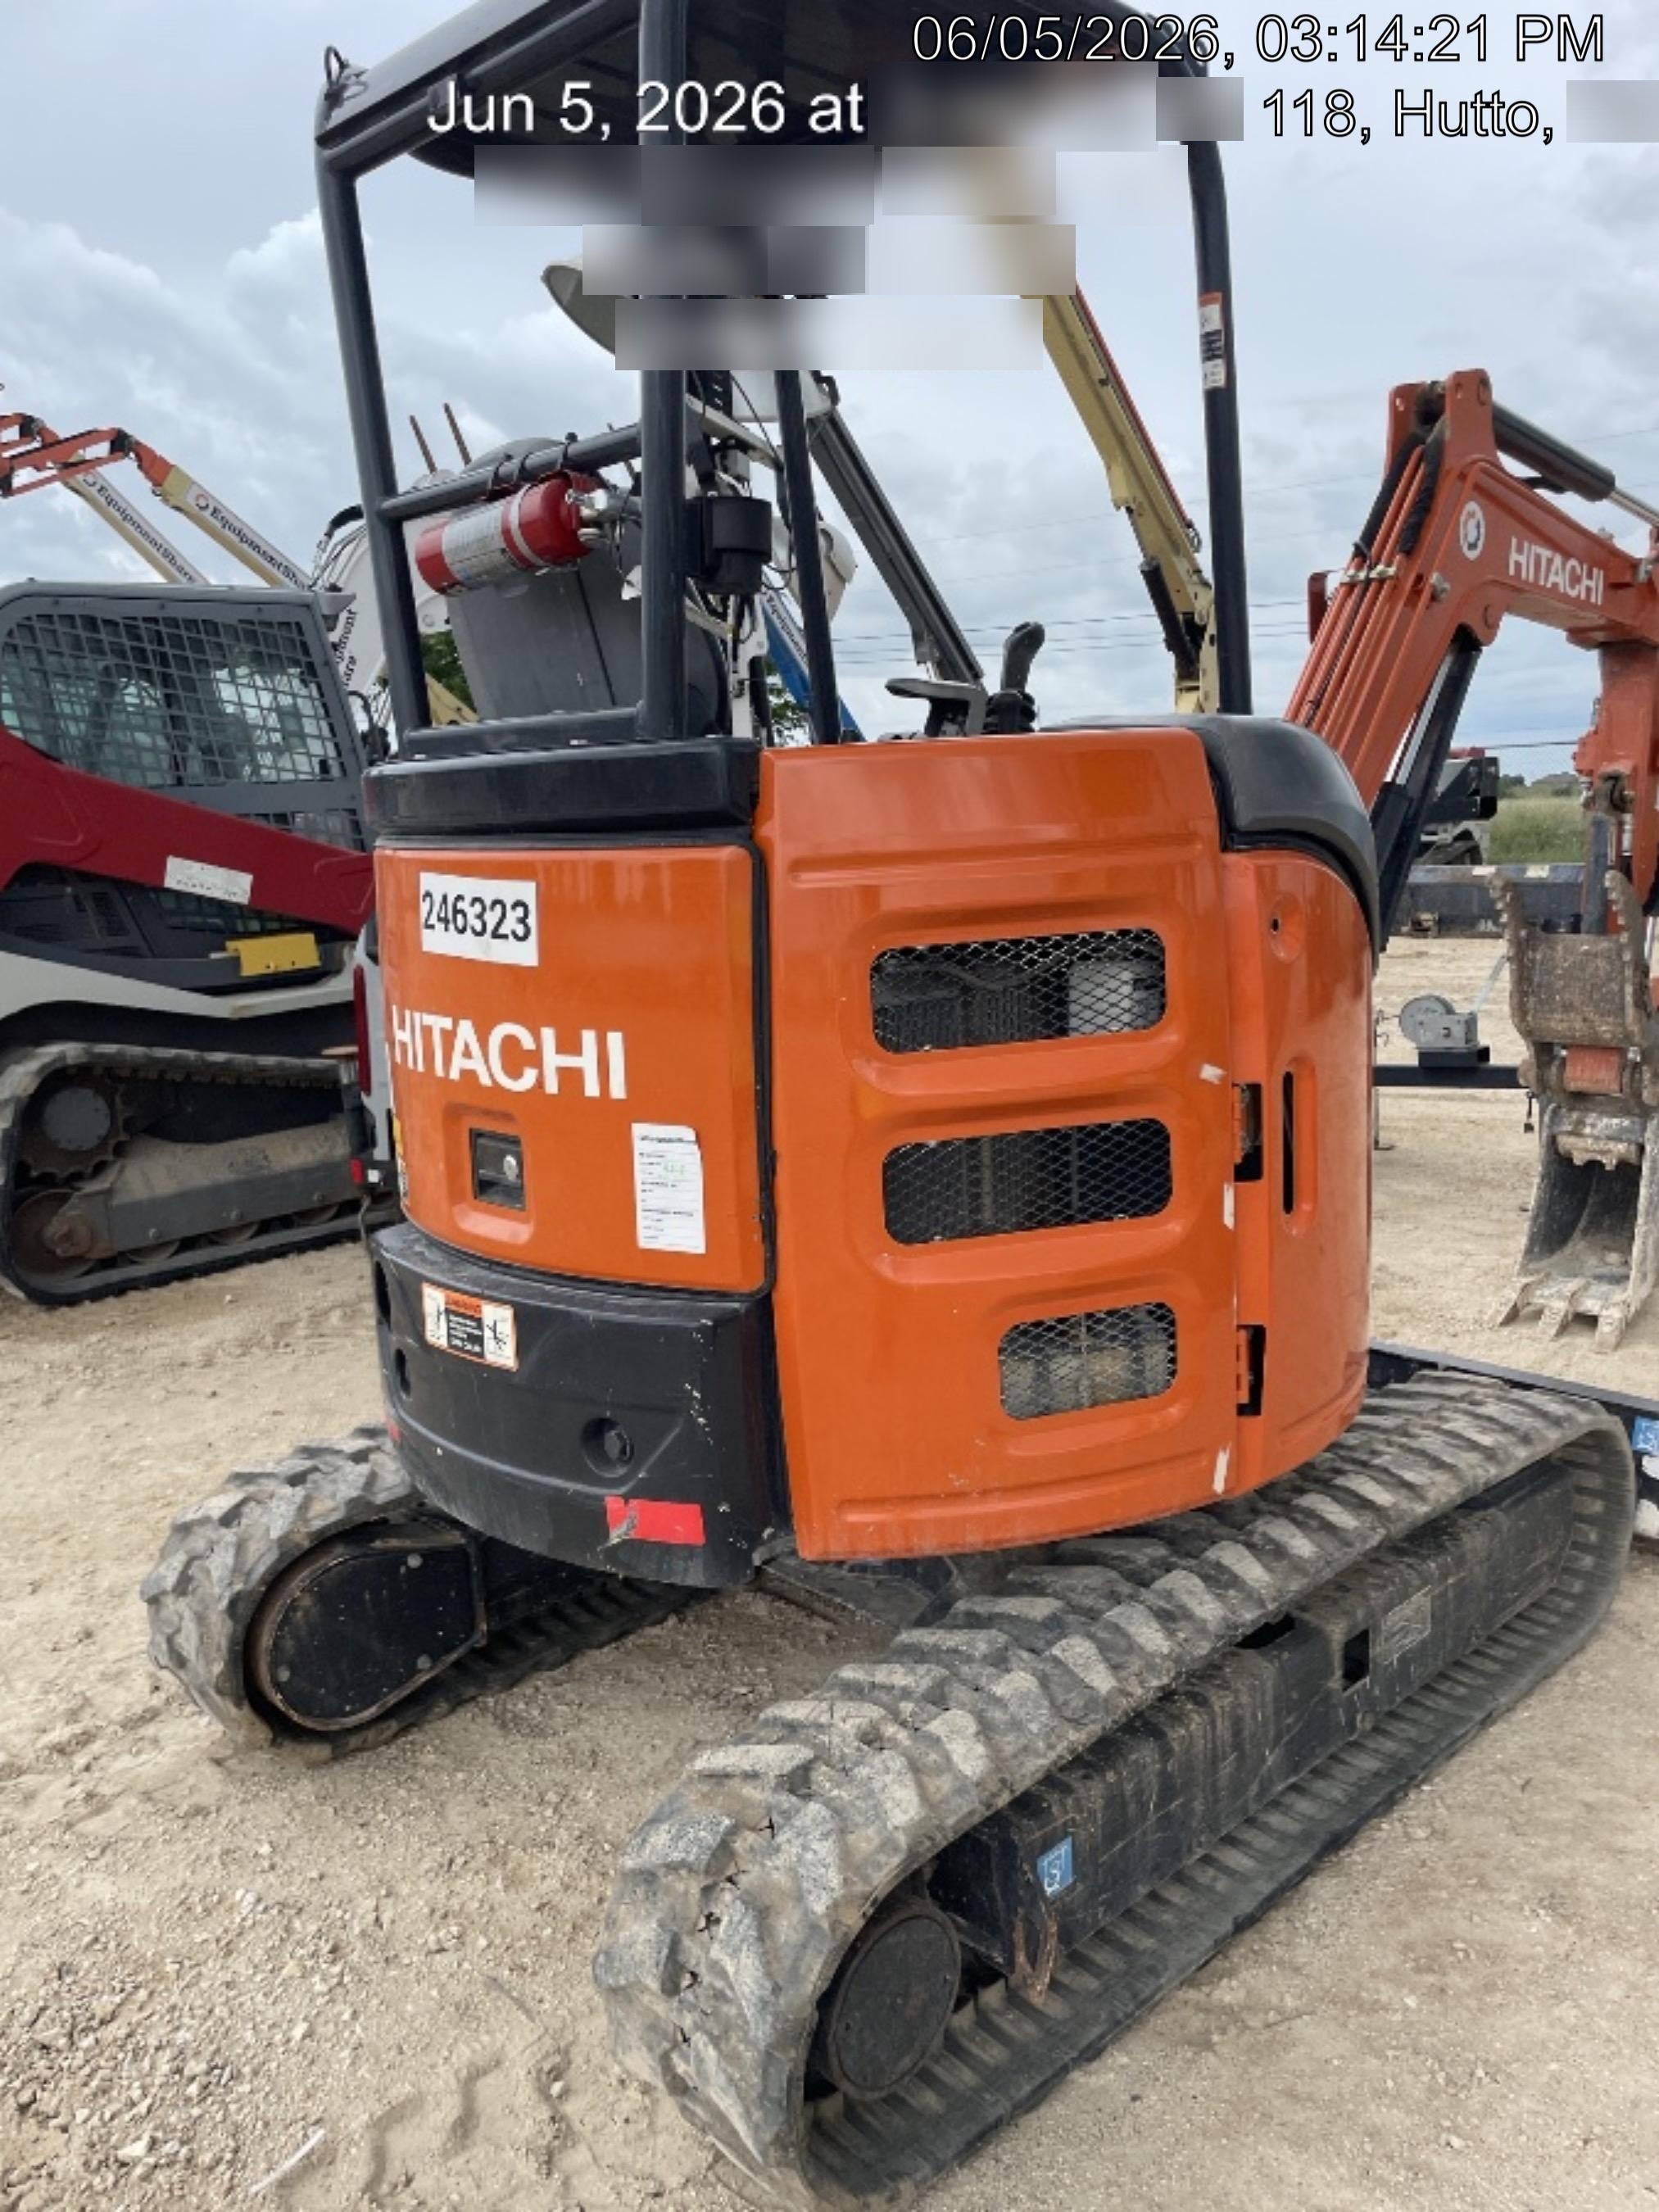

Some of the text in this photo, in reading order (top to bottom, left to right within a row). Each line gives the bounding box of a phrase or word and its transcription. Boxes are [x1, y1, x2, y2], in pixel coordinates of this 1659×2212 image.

[1508, 535, 1604, 605] HITACHI
[421, 890, 533, 943] 246323
[392, 1004, 628, 1100] HITACHI
